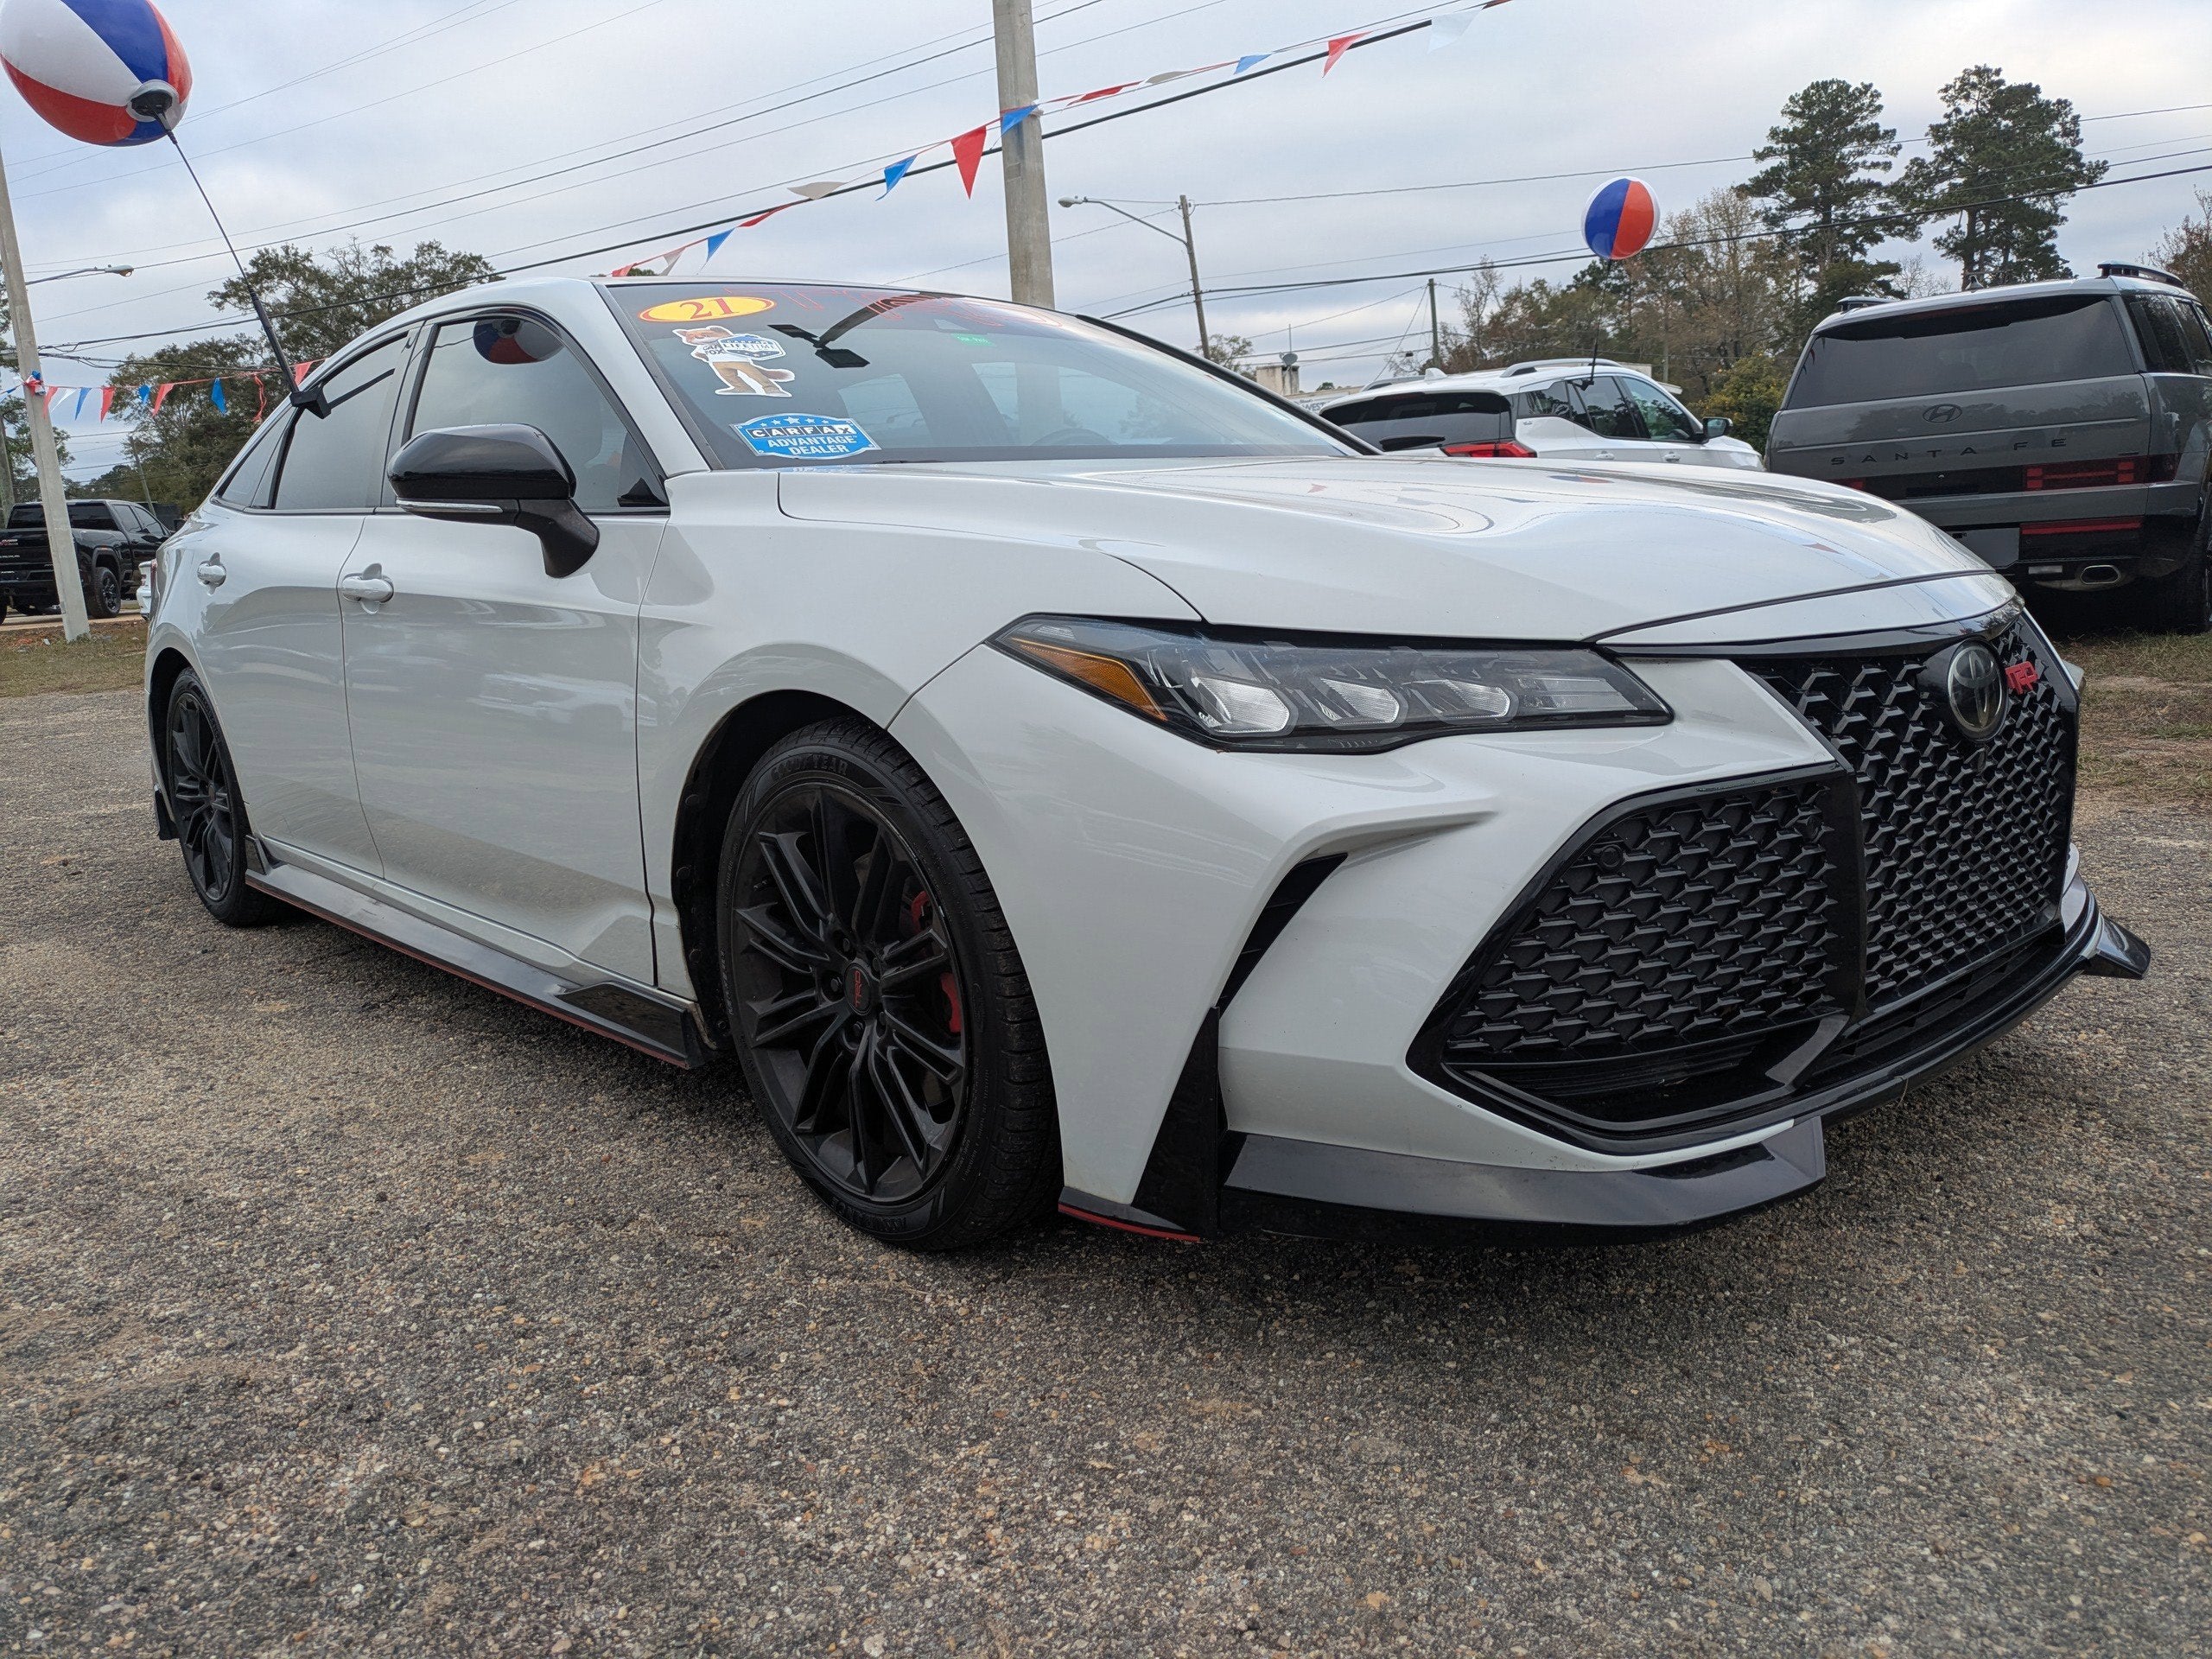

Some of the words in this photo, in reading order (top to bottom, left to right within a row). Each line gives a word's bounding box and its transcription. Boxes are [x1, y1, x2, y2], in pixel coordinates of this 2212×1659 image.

[679, 297, 740, 319] 21
[751, 424, 855, 438] CARFAX
[767, 435, 857, 448] ADVANTAGE
[787, 445, 850, 455] DEALER
[1830, 445, 1978, 467] SANTA
[2012, 437, 2068, 451] FE
[853, 969, 862, 1009] TRD
